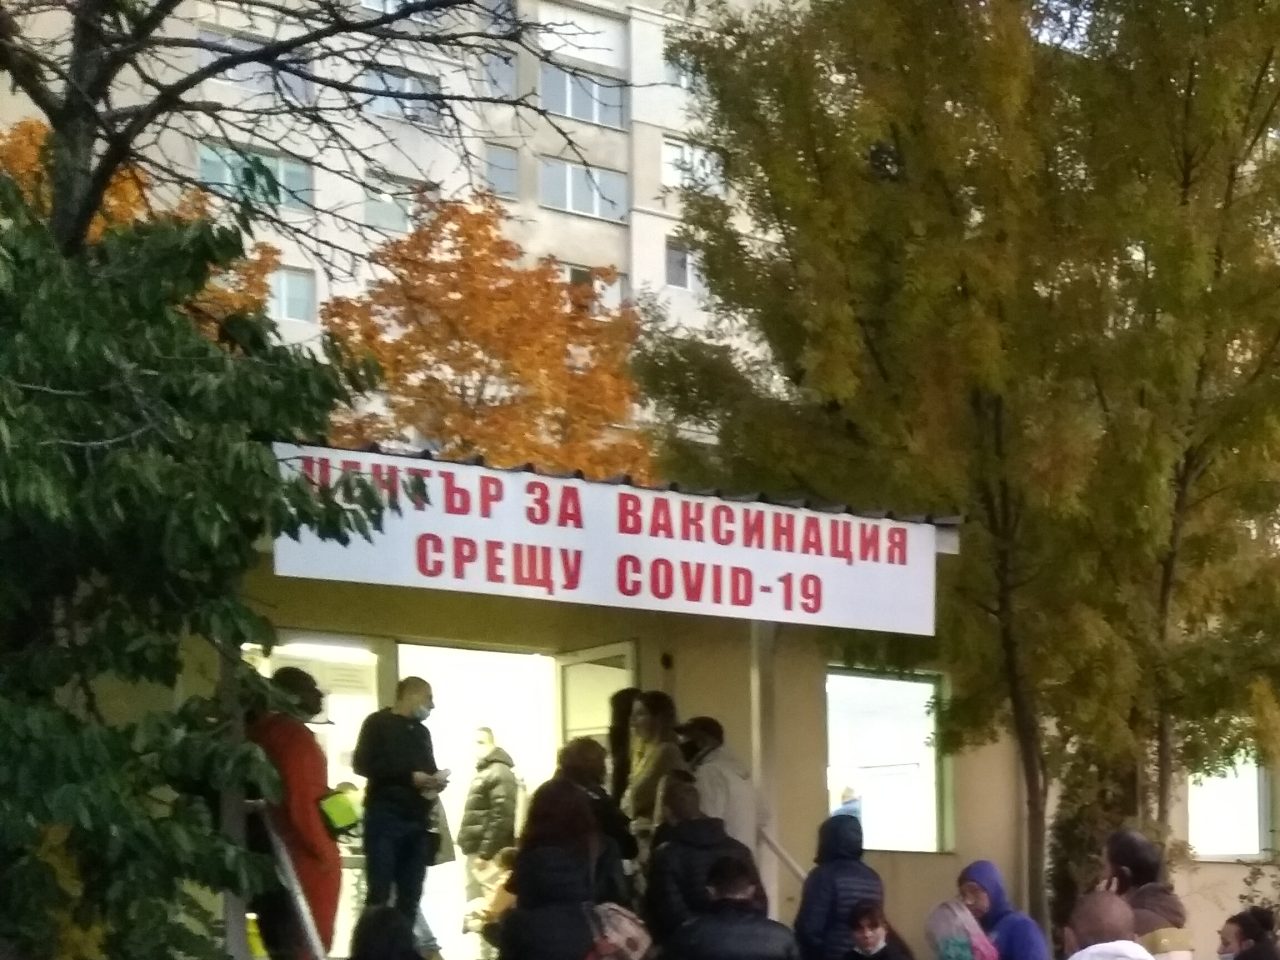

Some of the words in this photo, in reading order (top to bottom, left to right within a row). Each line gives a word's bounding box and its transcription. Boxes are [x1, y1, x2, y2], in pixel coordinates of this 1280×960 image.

[526, 480, 584, 530] ЗА
[617, 490, 910, 566] ВАКСИНАЦИЯ
[415, 531, 584, 594] СРЕЩУ
[616, 553, 824, 615] COVID-19
